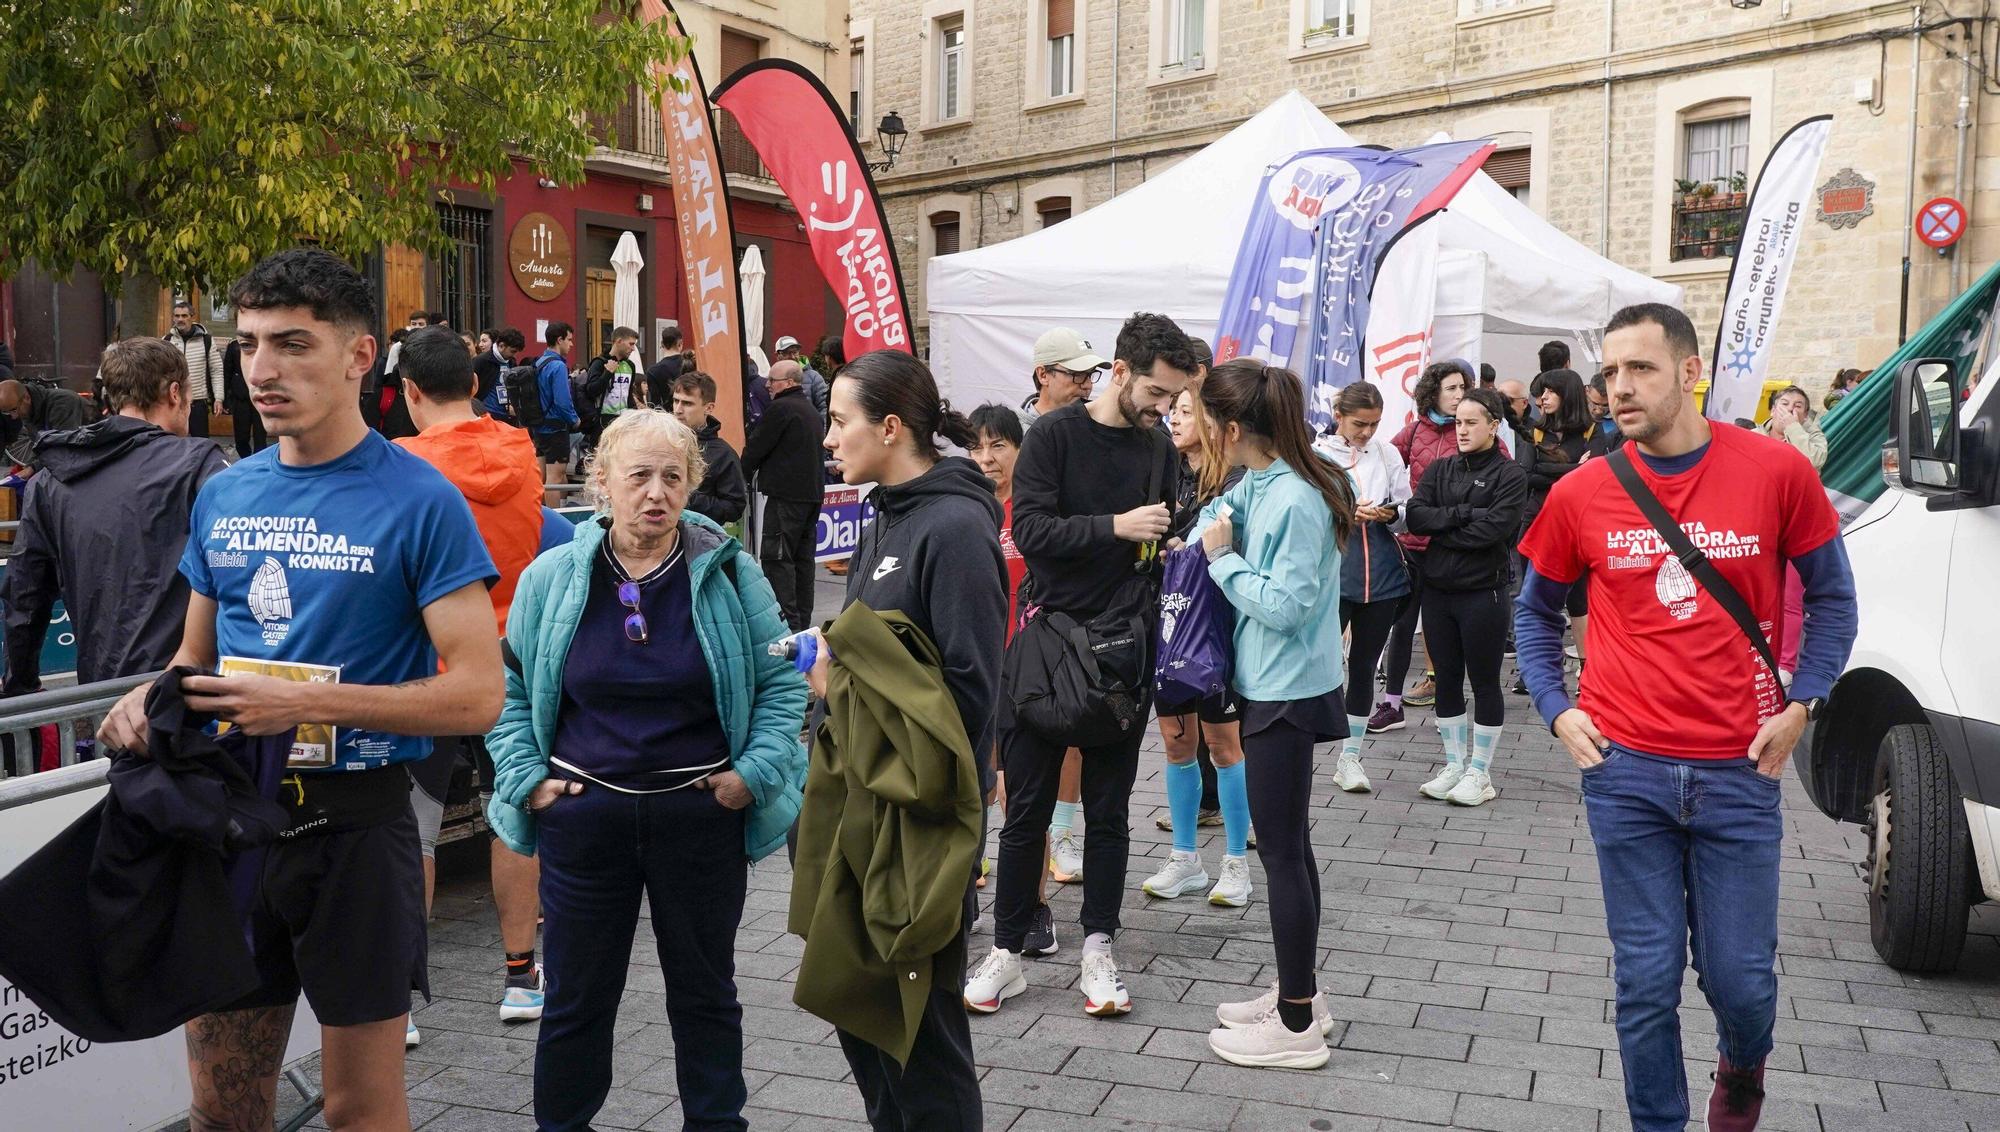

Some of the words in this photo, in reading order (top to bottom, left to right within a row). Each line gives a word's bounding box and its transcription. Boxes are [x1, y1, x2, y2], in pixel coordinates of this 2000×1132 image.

[520, 259, 564, 275] Ausarta
[1732, 298, 1750, 343] daño
[1749, 218, 1772, 293] cerebral
[213, 517, 226, 531] LA
[228, 516, 317, 533] CONQUISTA
[815, 505, 875, 552] Diari
[1607, 531, 1624, 542] LA
[1626, 521, 1706, 541] CONSTA
[211, 531, 219, 540] DE
[219, 530, 231, 539] LA
[226, 532, 350, 555] ALMENDRA
[350, 545, 374, 557] REN
[1620, 540, 1630, 548] LA
[1629, 529, 1740, 555] ALMDRA
[1740, 534, 1759, 545] REN
[1699, 544, 1761, 560] ONKISTA
[288, 554, 375, 573] KONKISTA
[1615, 555, 1651, 569] Edición
[0, 1035, 92, 1085] steizko
